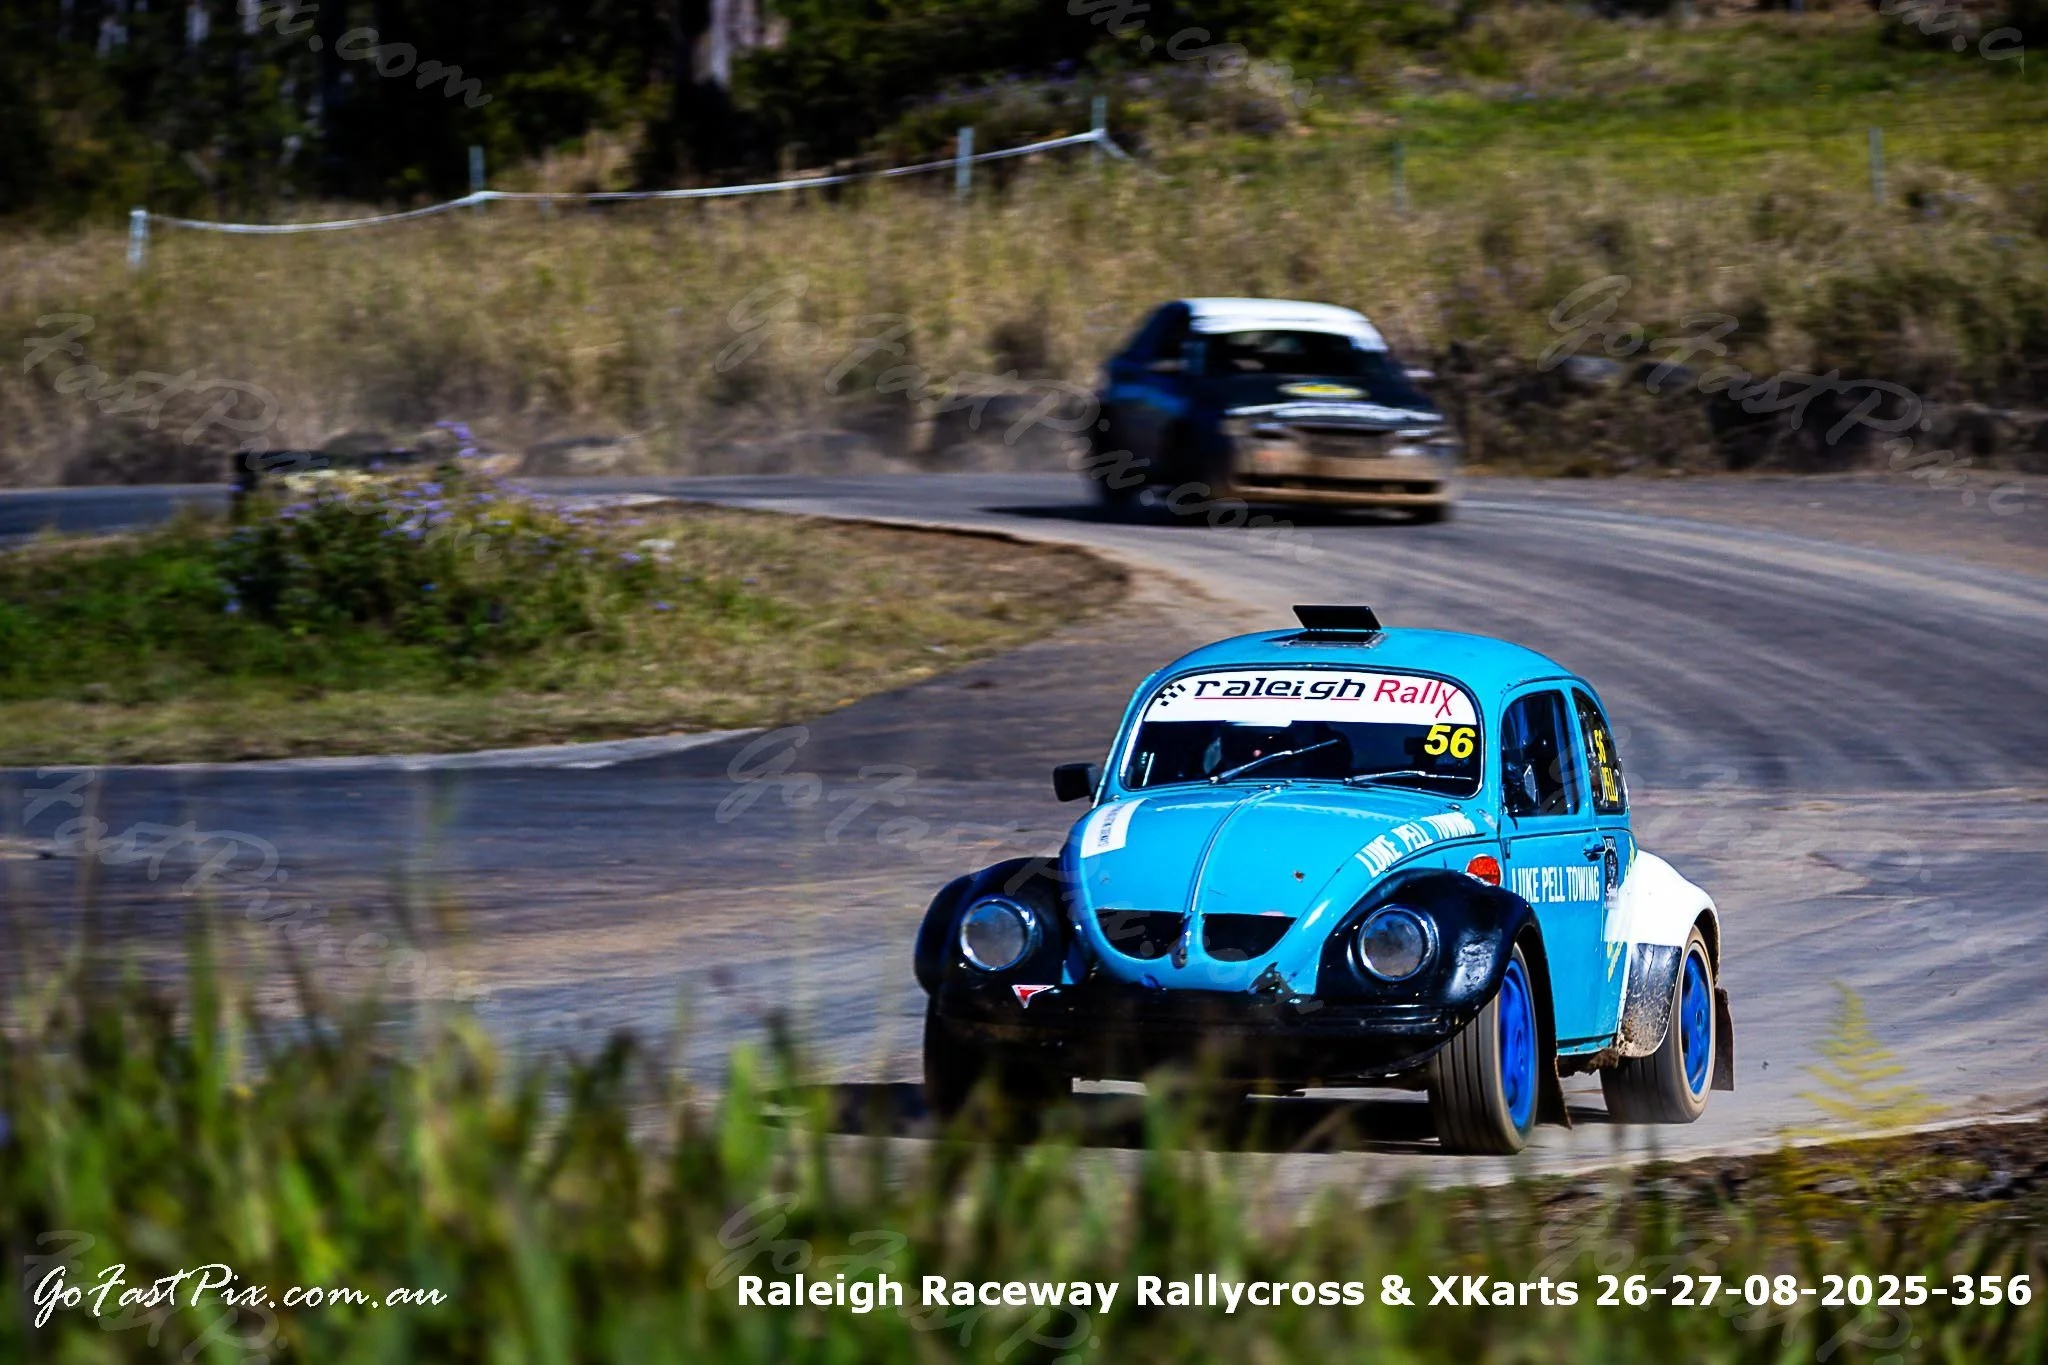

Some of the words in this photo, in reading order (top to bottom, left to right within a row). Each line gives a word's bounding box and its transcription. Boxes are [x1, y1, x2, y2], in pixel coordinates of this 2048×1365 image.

[1194, 677, 1366, 700] raleigh
[1424, 724, 1476, 759] 56
[1594, 729, 1607, 763] 56
[1354, 834, 1404, 879] LUKE
[1391, 821, 1434, 853] PELL
[1421, 811, 1476, 840] TOWING
[1541, 866, 1566, 903] PELL
[1566, 865, 1600, 902] TOWING
